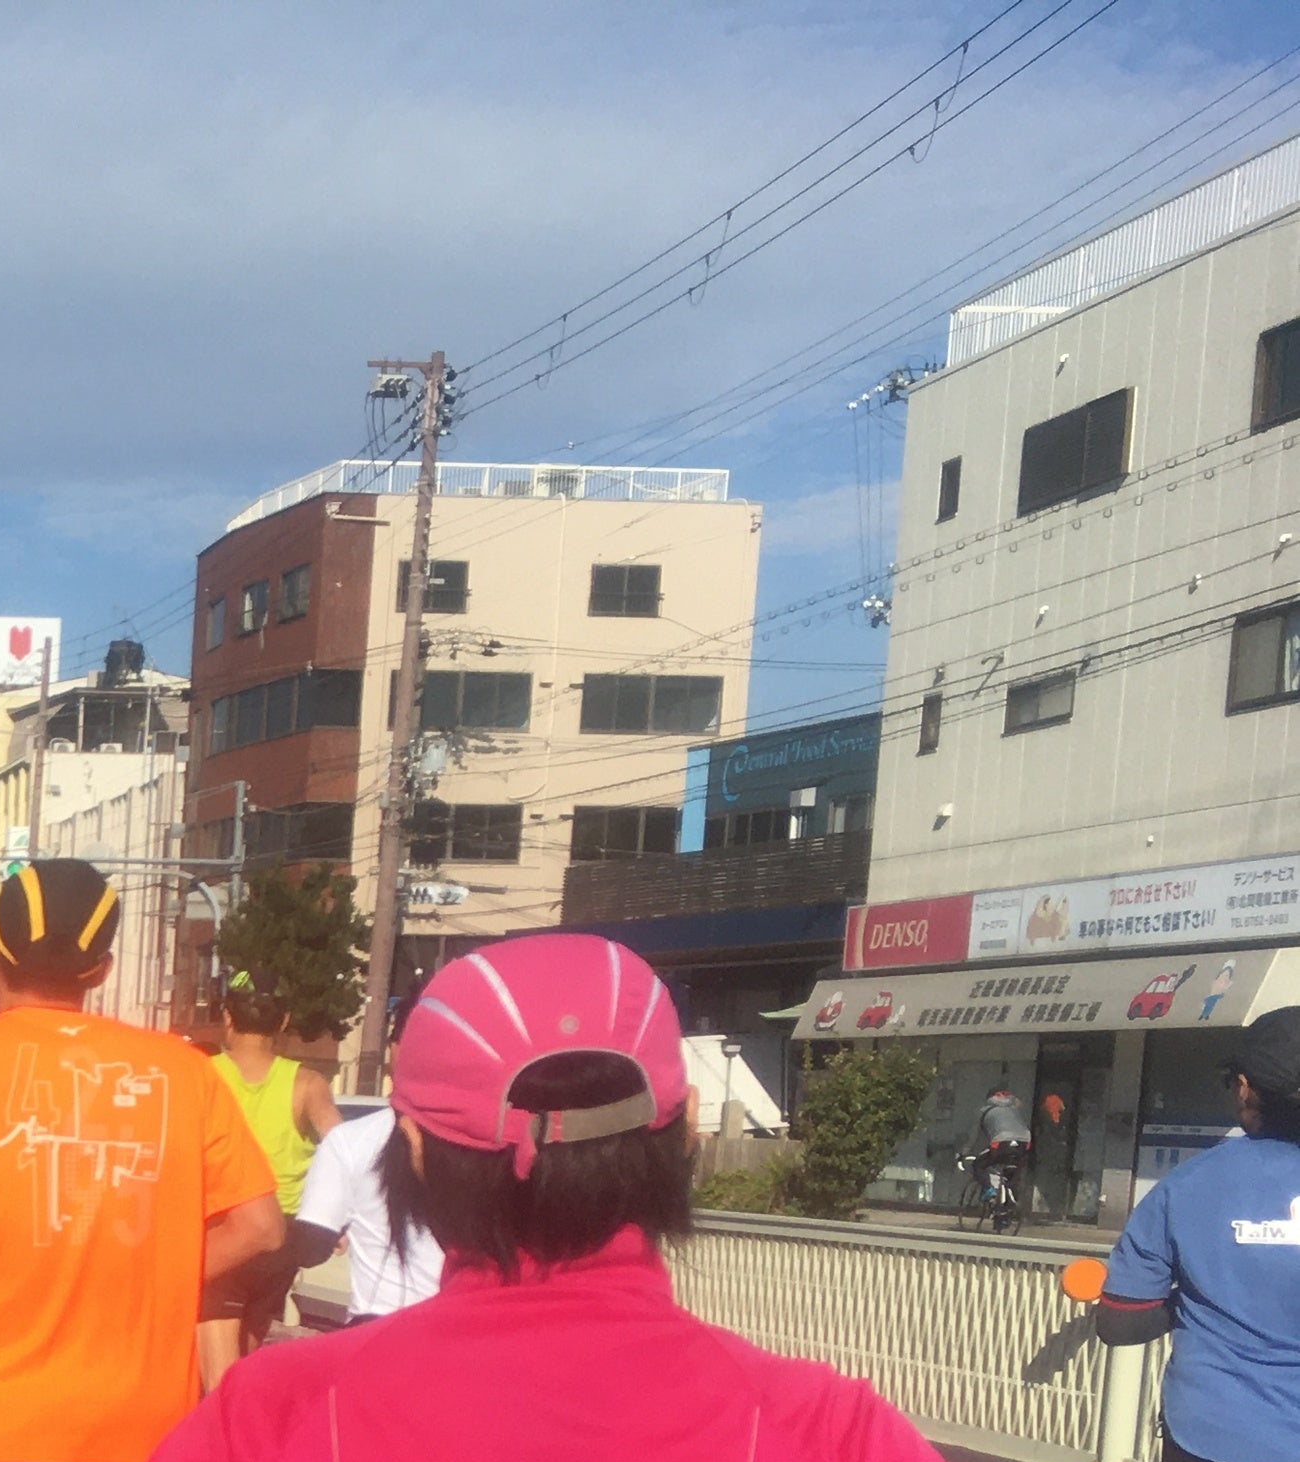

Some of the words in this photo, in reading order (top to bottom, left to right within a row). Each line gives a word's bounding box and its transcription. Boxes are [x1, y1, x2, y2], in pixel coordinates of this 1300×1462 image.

[1234, 866, 1294, 886] デンソーサービス
[870, 920, 928, 950] DENSO
